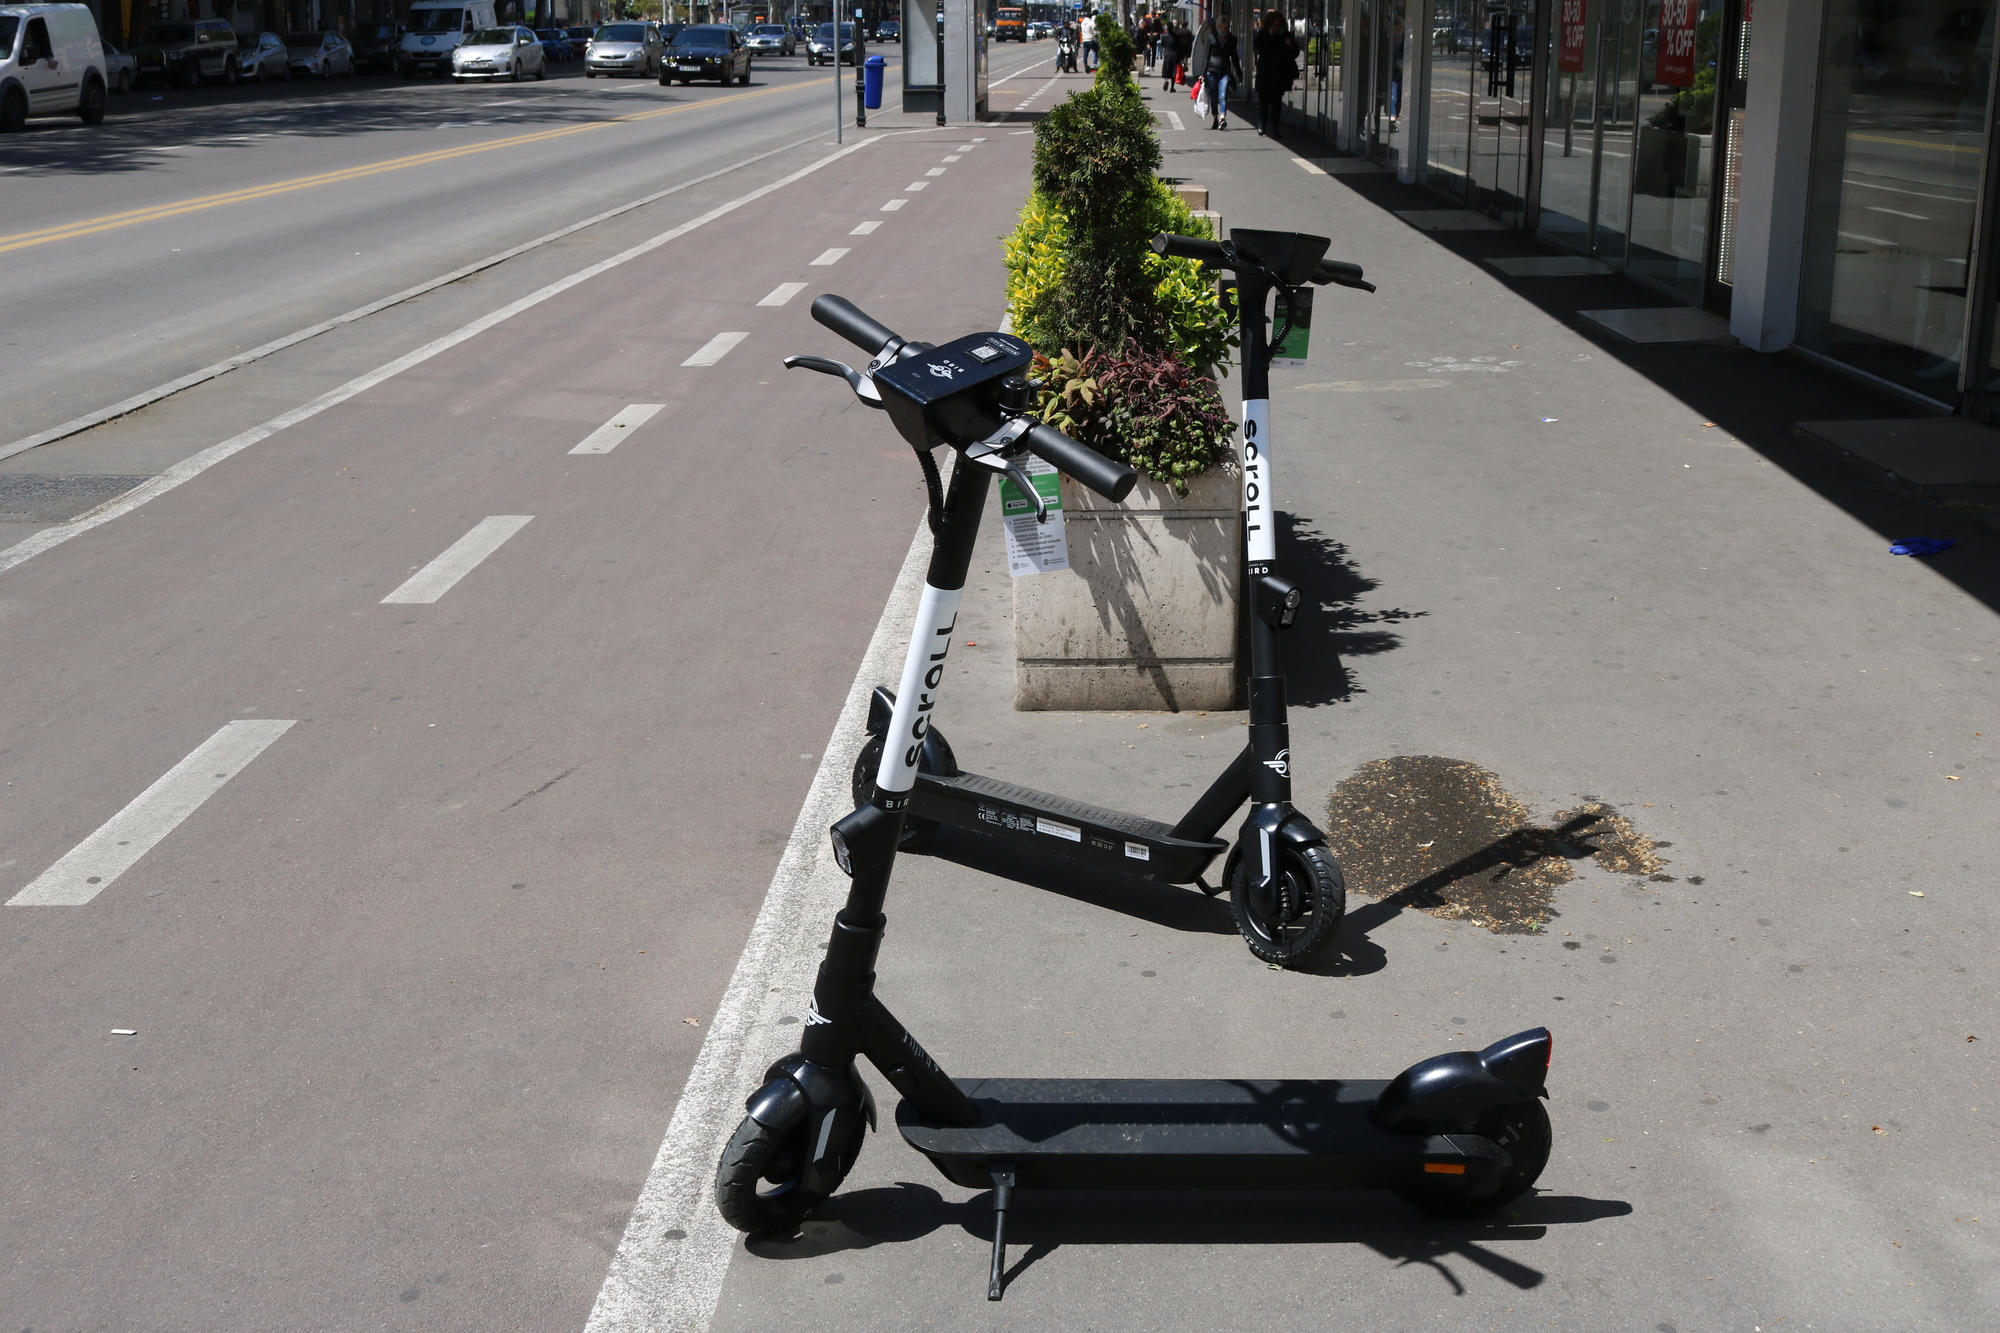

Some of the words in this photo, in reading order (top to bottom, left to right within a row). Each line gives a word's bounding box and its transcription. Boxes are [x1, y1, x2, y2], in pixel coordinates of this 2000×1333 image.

[1662, 0, 1688, 25] 30-50
[1572, 25, 1584, 48] OFF
[1666, 29, 1675, 56] %
[1676, 29, 1694, 57] OFF
[943, 359, 965, 373] BIRD
[885, 798, 909, 809] BIR
